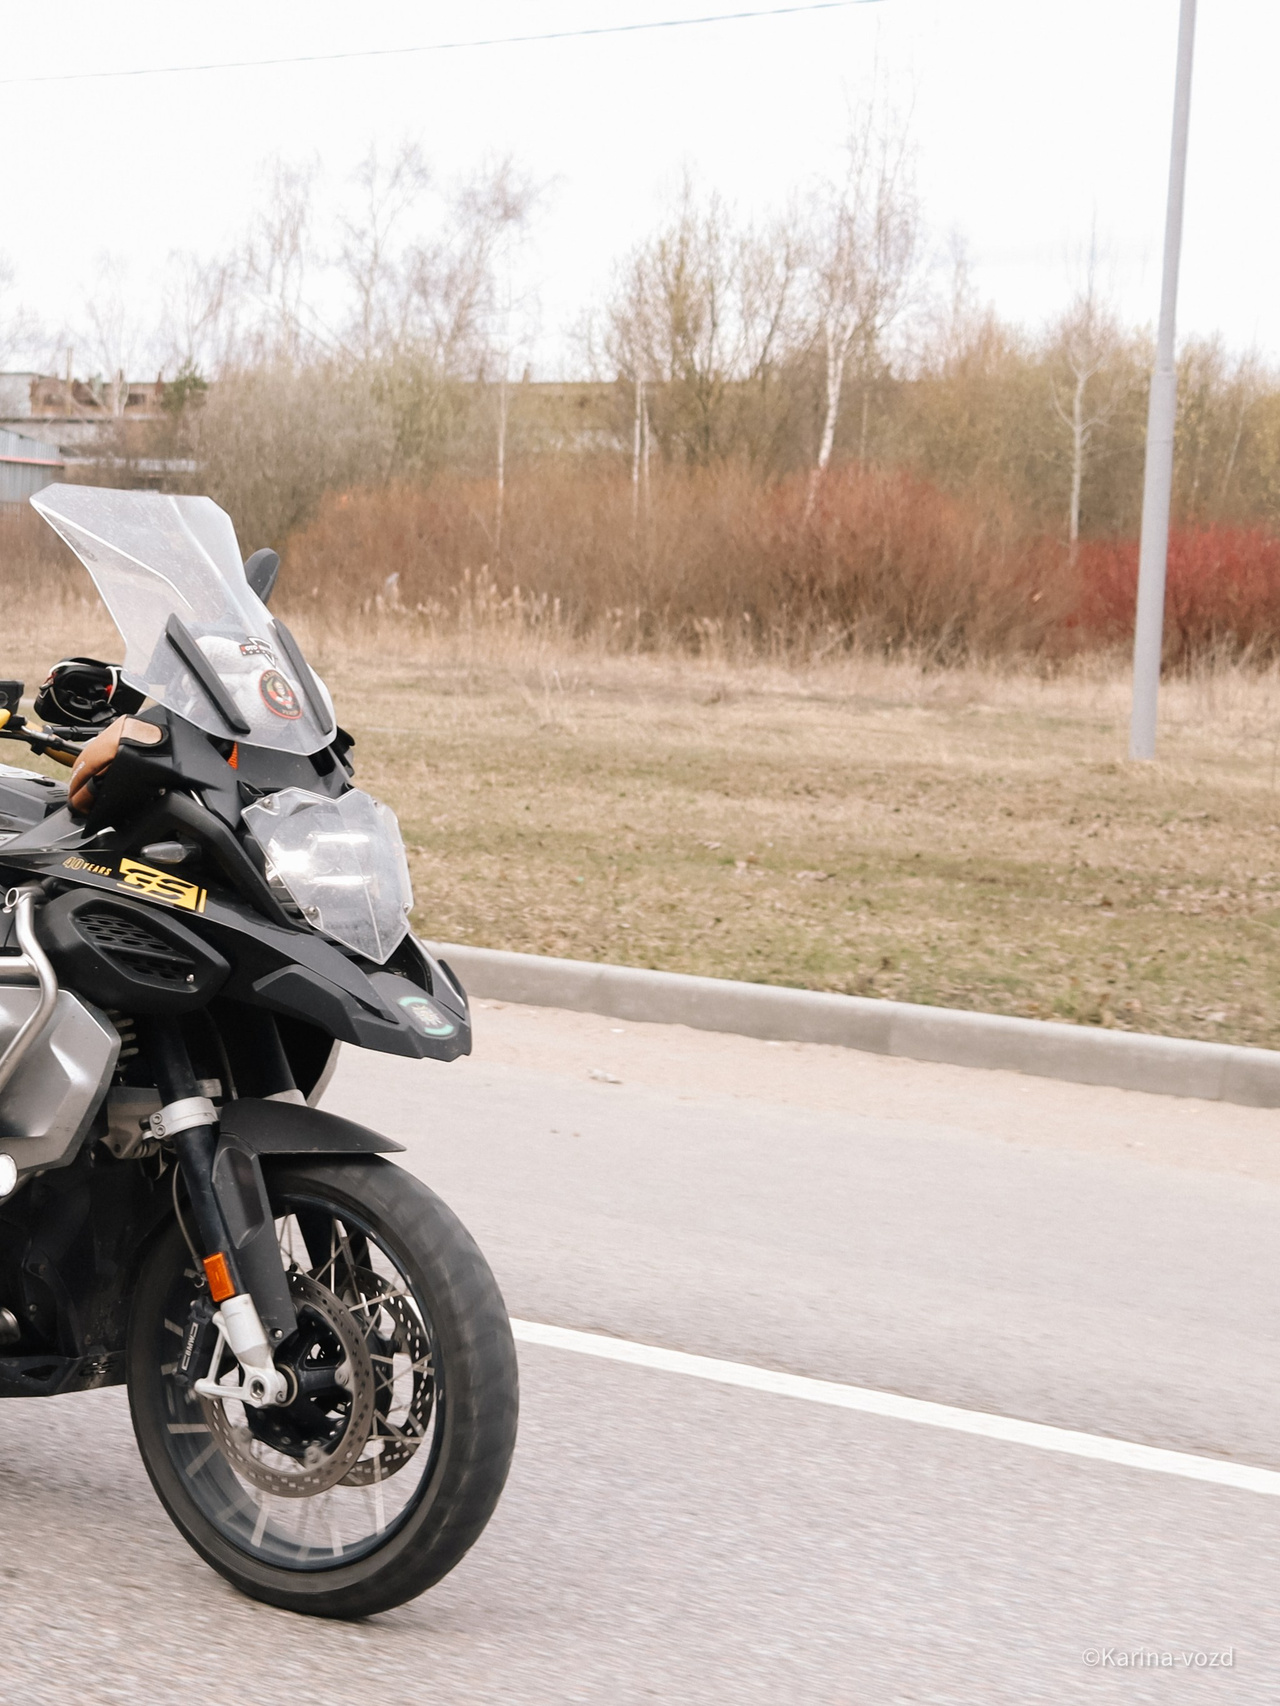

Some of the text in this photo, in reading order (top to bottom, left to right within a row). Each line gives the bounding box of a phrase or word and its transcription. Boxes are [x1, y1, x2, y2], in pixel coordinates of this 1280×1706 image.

[62, 856, 113, 877] 40 YEARS
[185, 1335, 195, 1356] BMW
